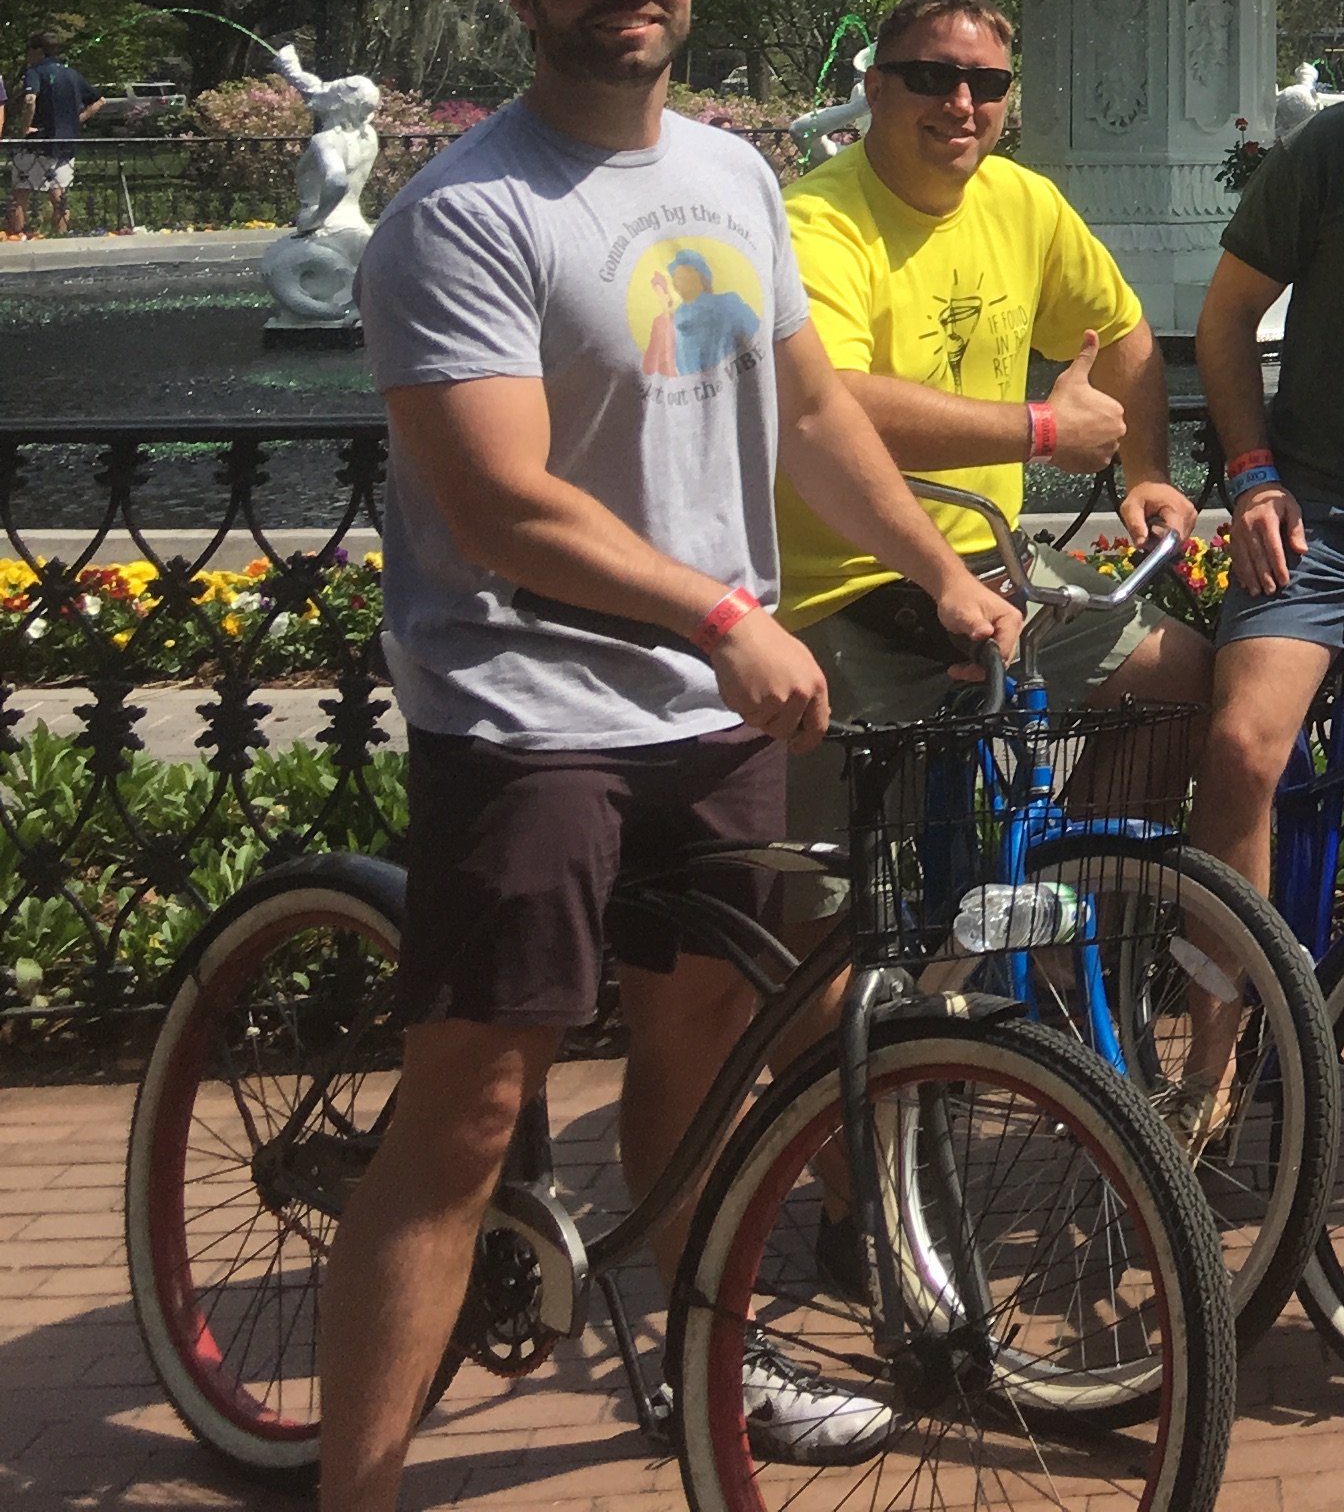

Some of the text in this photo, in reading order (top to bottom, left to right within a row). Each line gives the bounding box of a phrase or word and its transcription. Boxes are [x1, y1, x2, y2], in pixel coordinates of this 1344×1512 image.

[599, 234, 631, 284] Gonna
[622, 210, 661, 239] hang
[661, 204, 686, 225] by
[690, 204, 721, 225] the
[988, 313, 998, 335] IF
[996, 334, 1010, 355] IN
[693, 380, 723, 402] the
[724, 342, 767, 381] VIBE
